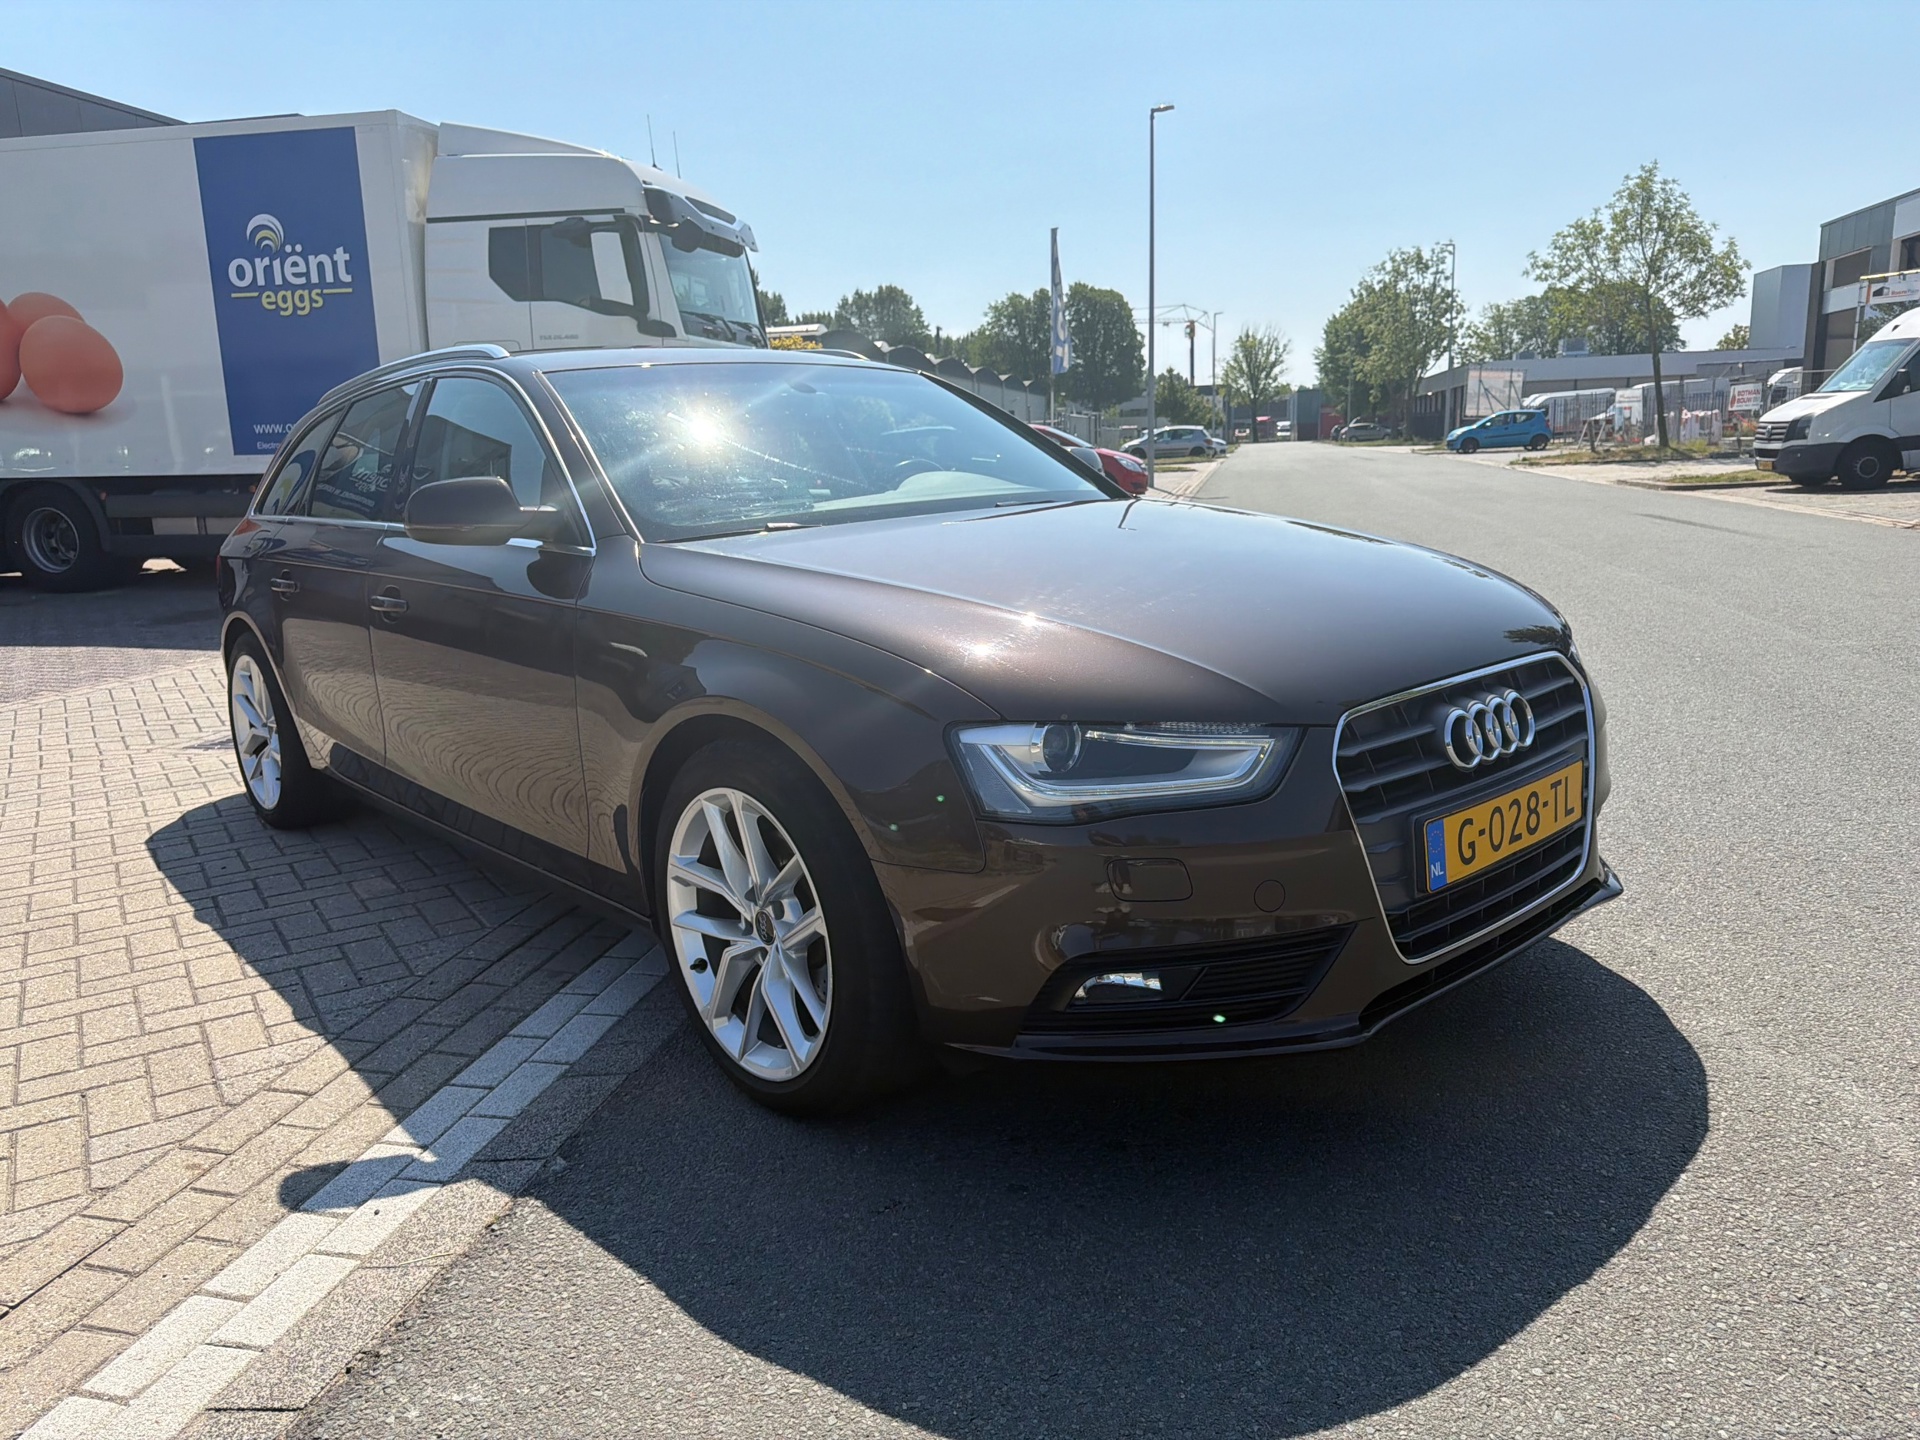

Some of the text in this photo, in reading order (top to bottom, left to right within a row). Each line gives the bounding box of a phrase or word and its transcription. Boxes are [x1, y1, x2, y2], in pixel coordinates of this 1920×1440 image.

[228, 243, 353, 288] oriënt
[261, 288, 324, 316] eggs
[1457, 775, 1575, 866] G-028-TL
[1431, 861, 1445, 879] NL
